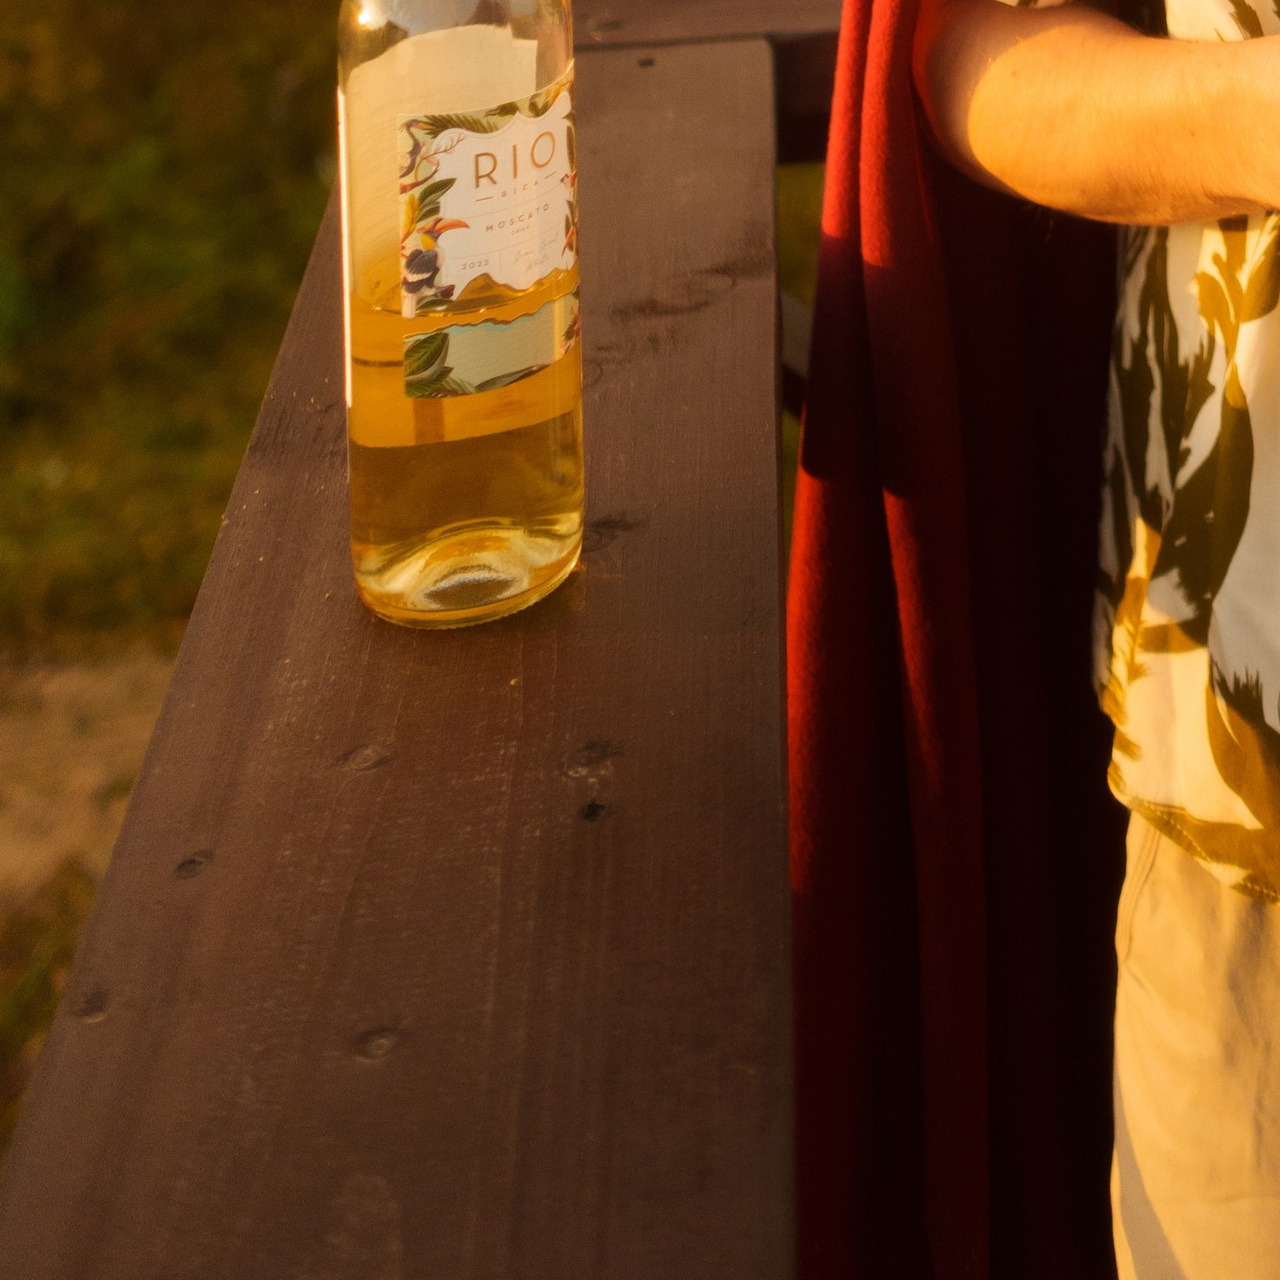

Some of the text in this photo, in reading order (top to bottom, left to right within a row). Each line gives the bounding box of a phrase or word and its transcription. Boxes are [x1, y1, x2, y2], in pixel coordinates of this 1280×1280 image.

[475, 131, 555, 188] RIO
[502, 180, 538, 197] RICA
[486, 204, 549, 232] MOSCATO
[461, 260, 489, 271] 2023
